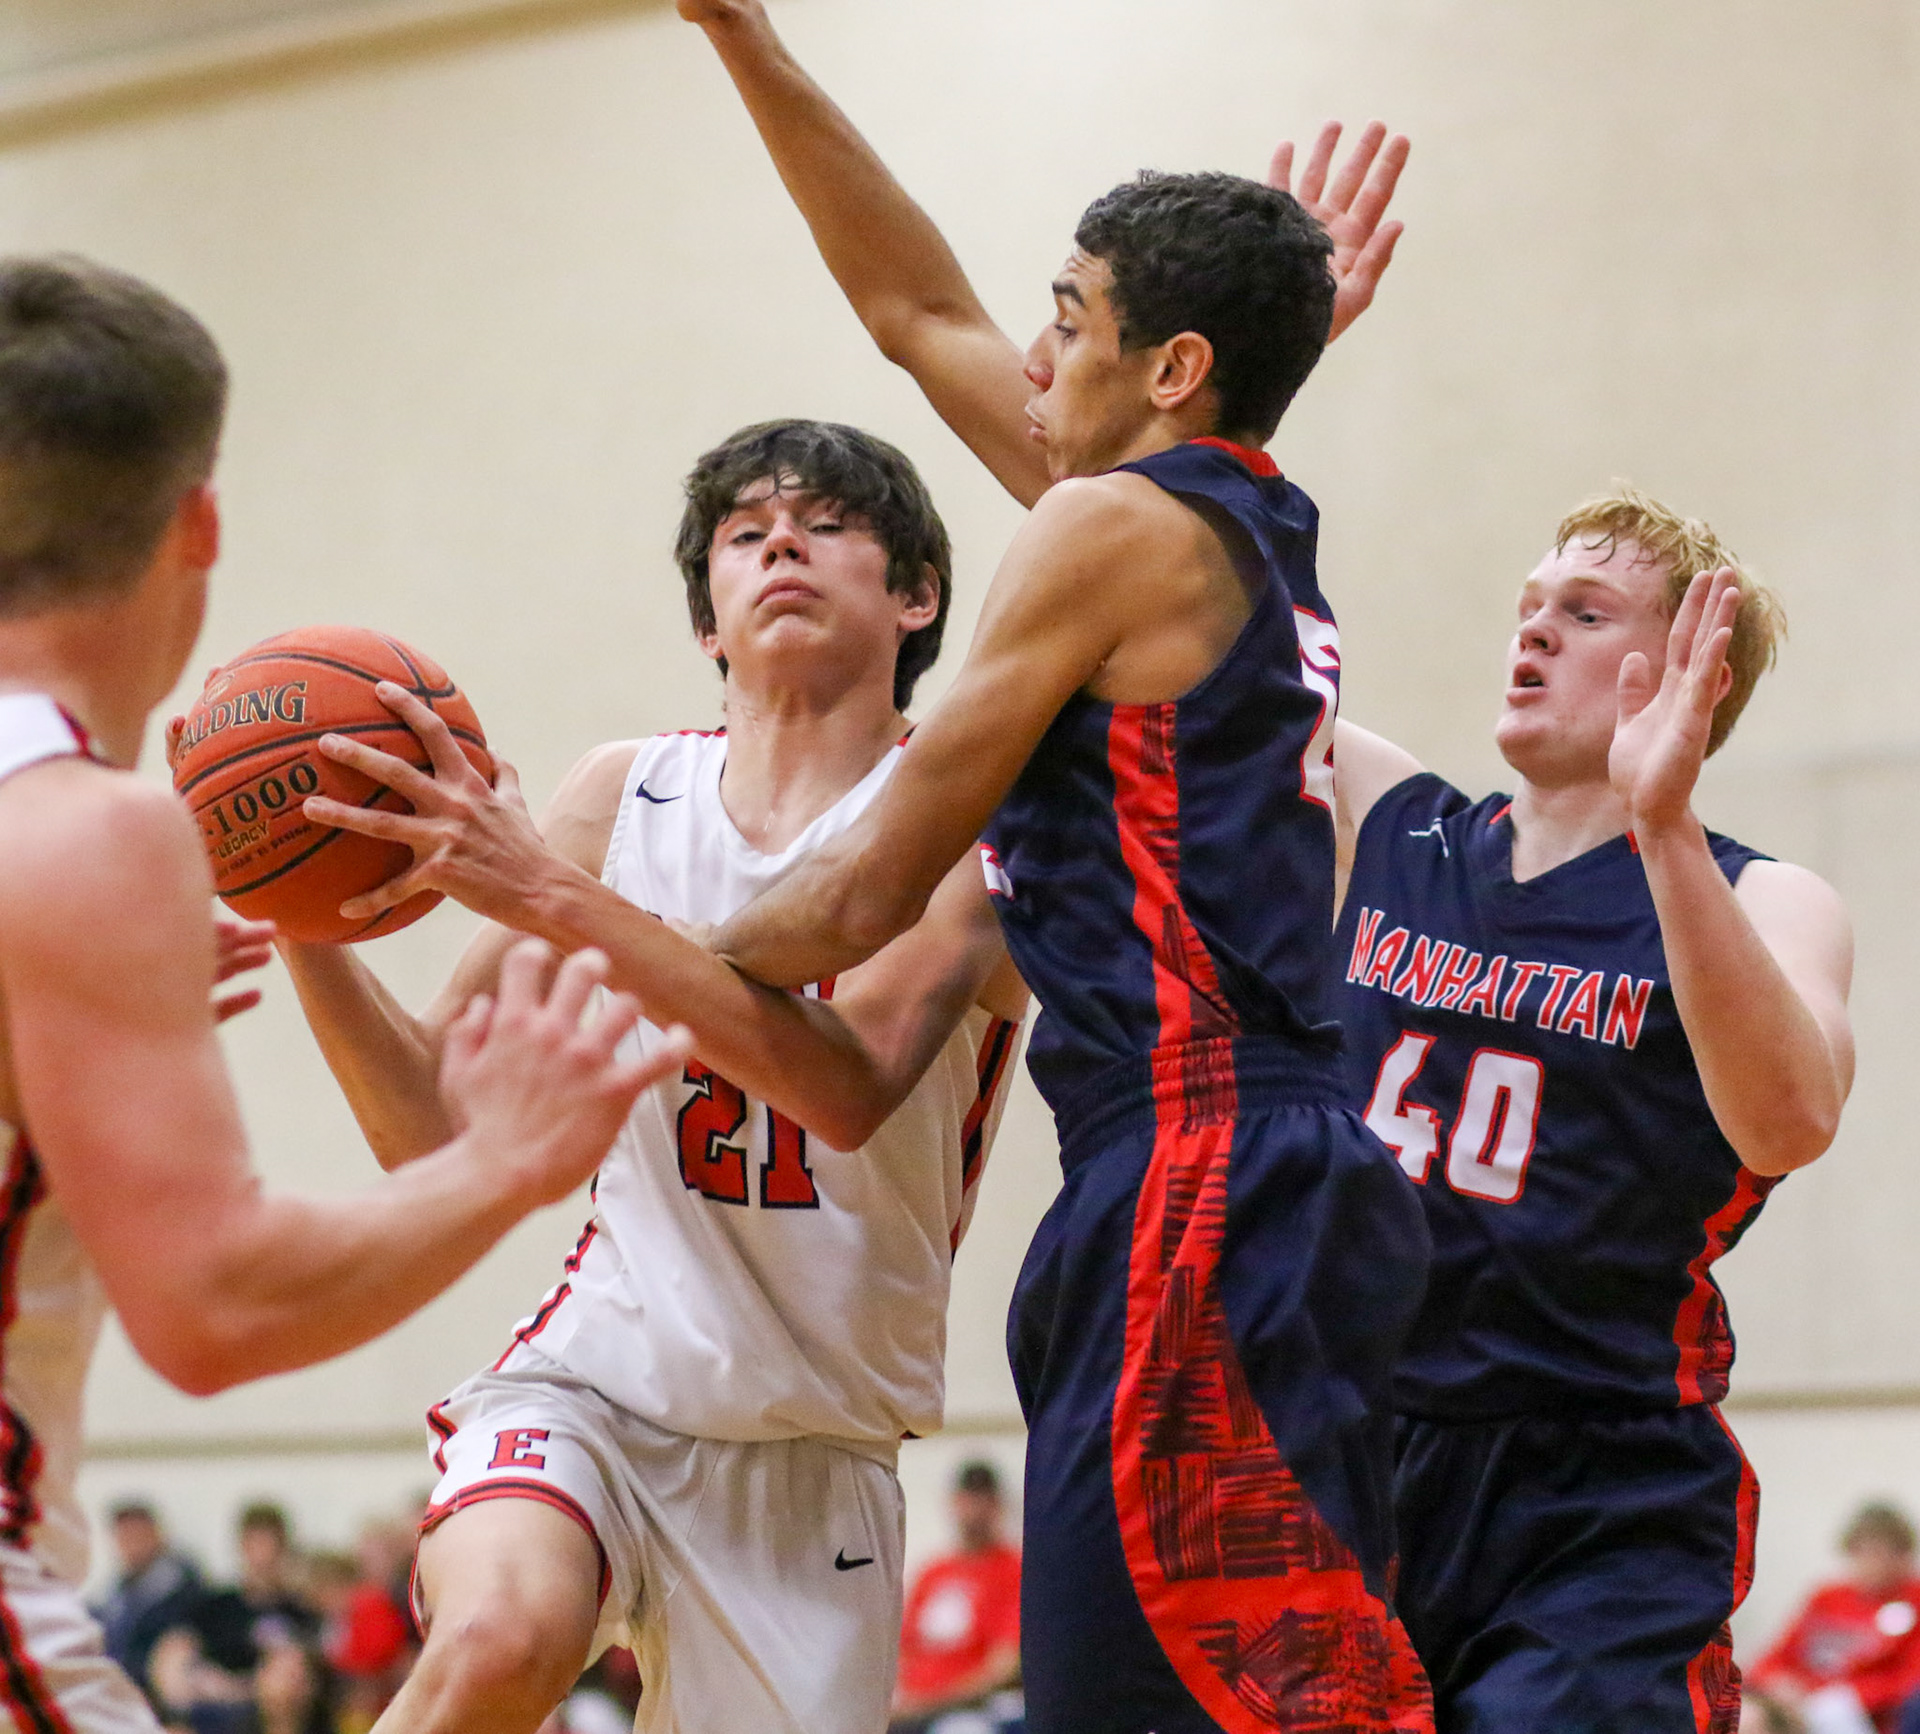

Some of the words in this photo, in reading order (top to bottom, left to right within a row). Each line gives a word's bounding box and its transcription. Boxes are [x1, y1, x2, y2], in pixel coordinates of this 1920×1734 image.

[217, 820, 269, 858] LEGACY
[1346, 906, 1655, 1050] MANHATTAN
[677, 1058, 820, 1210] 21
[1362, 1029, 1545, 1206] 40
[487, 1428, 550, 1471] E
